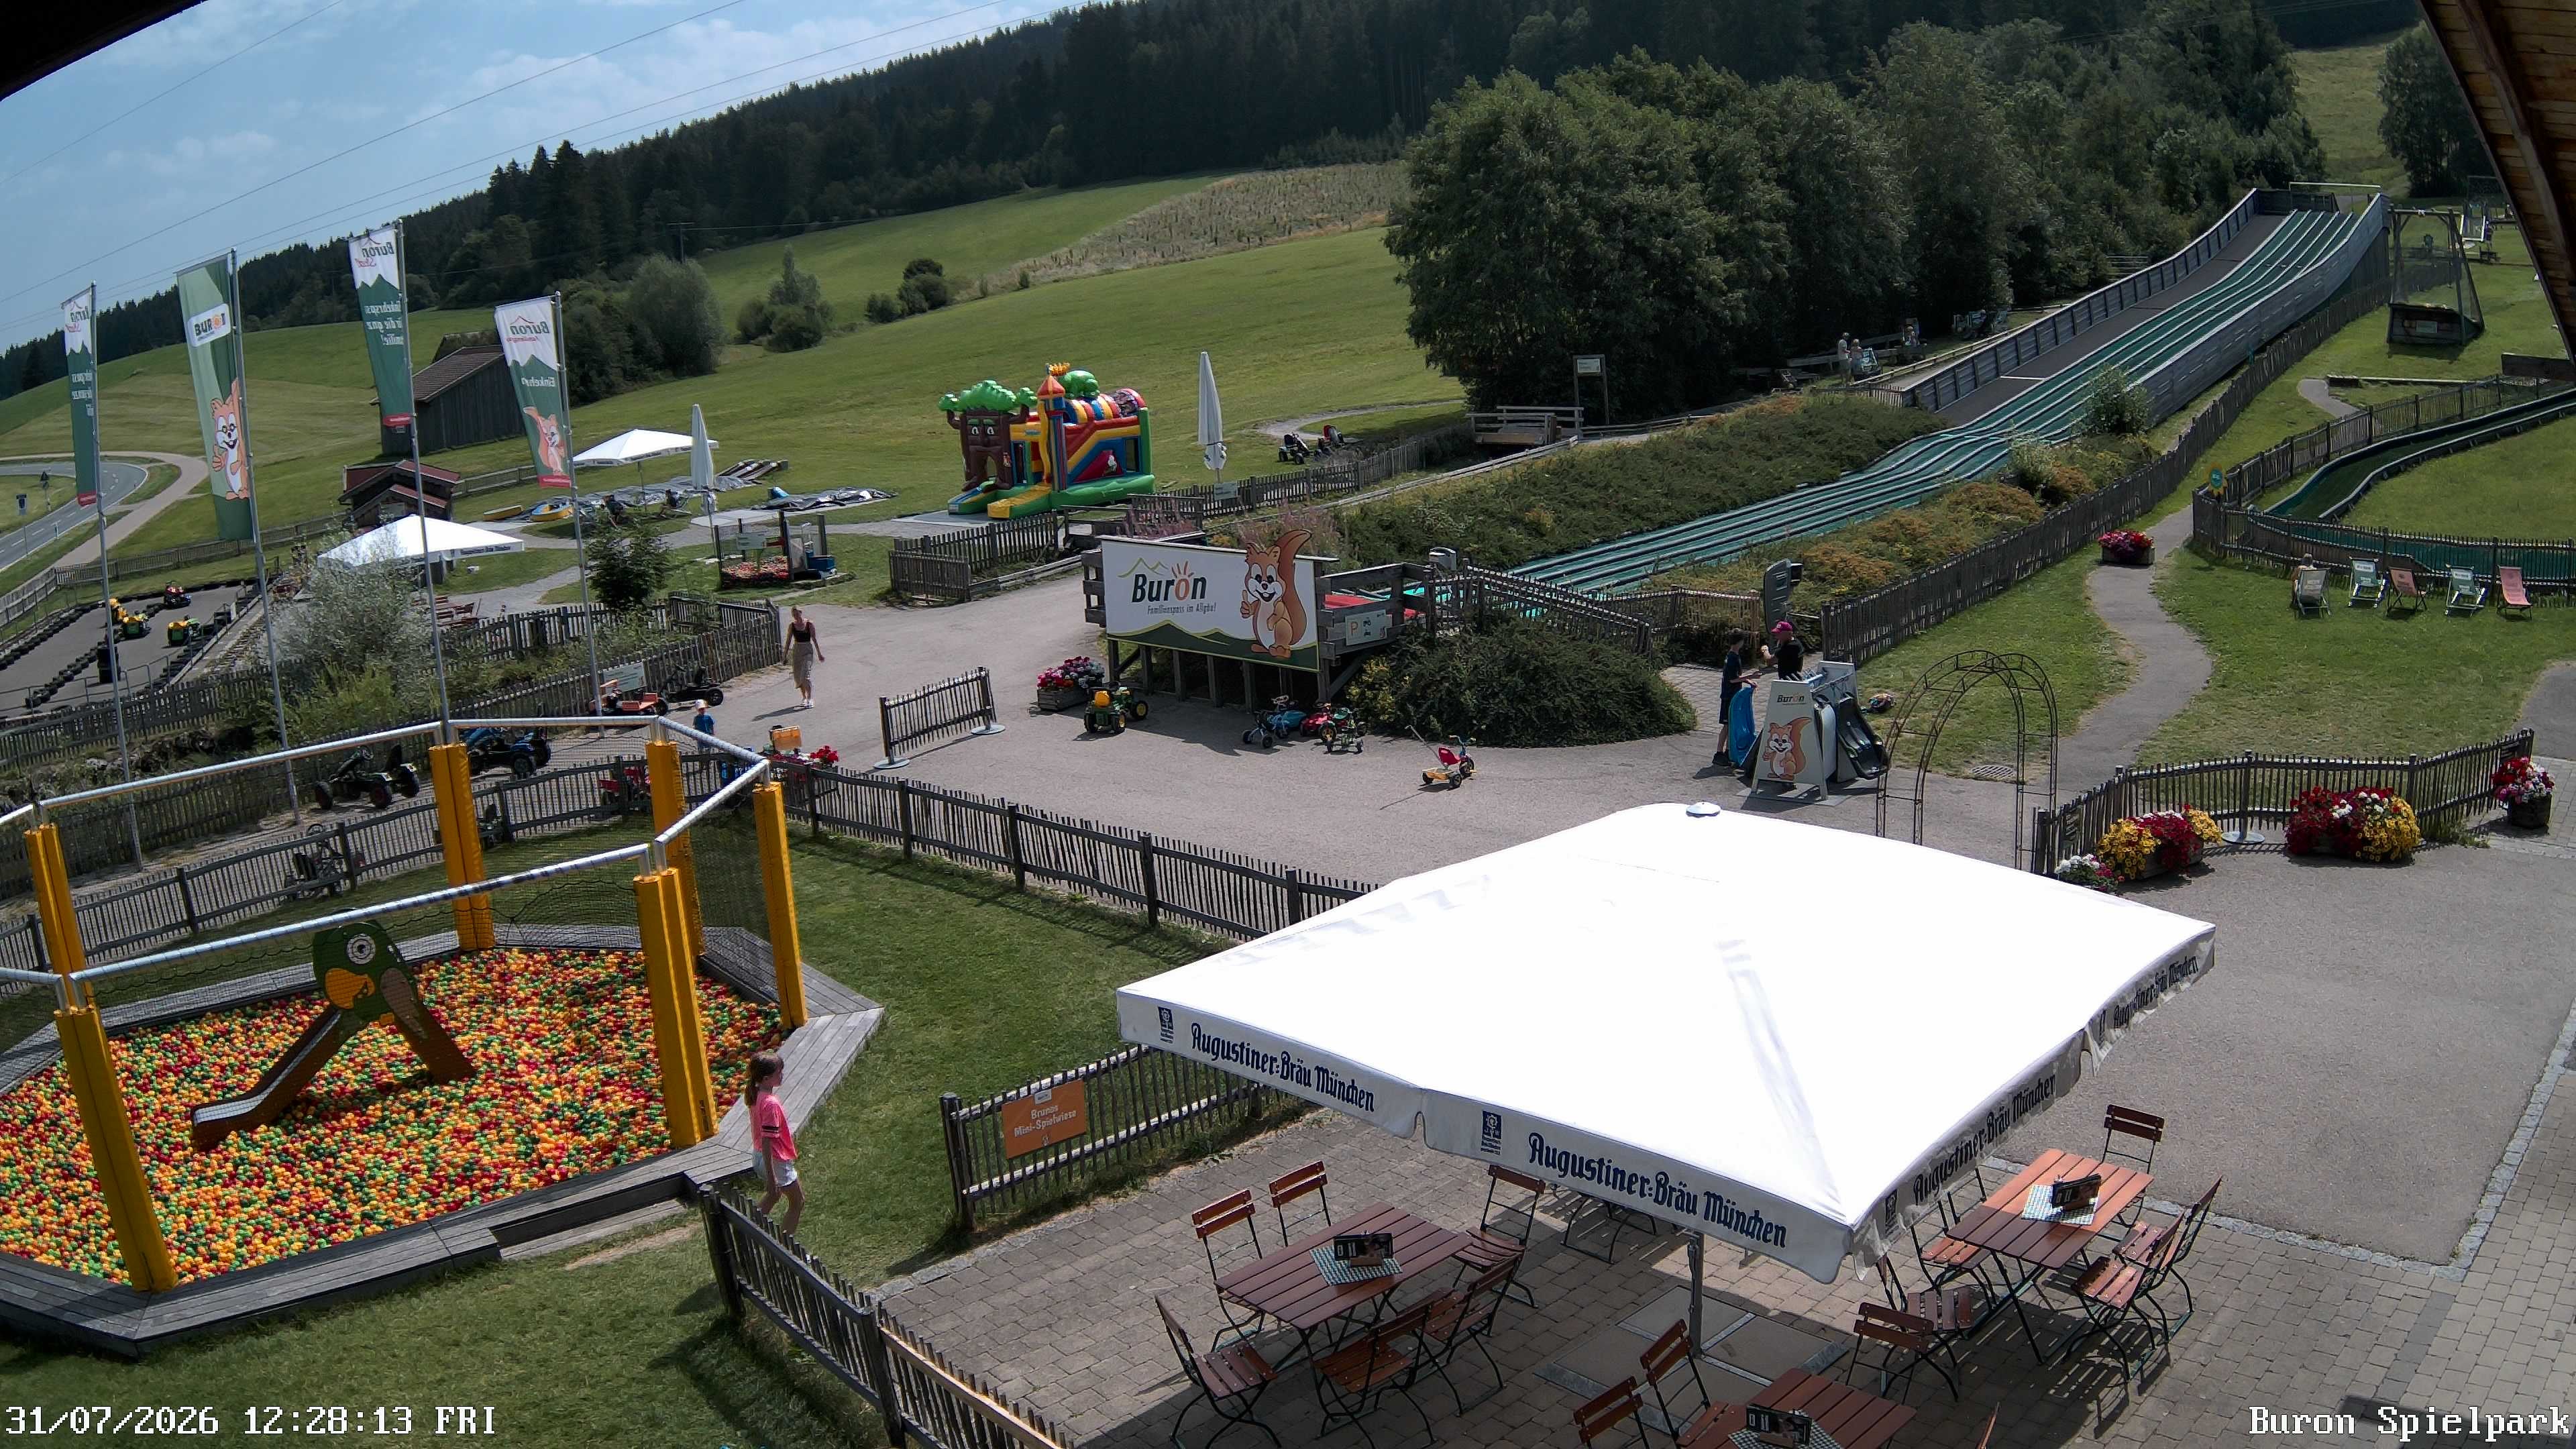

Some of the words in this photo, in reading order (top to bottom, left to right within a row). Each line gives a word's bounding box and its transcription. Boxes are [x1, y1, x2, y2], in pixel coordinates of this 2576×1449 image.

[1132, 574, 1208, 603] Buron
[1777, 694, 1805, 702] Buron
[1314, 1065, 1374, 1112] München
[1703, 1191, 1786, 1248] München
